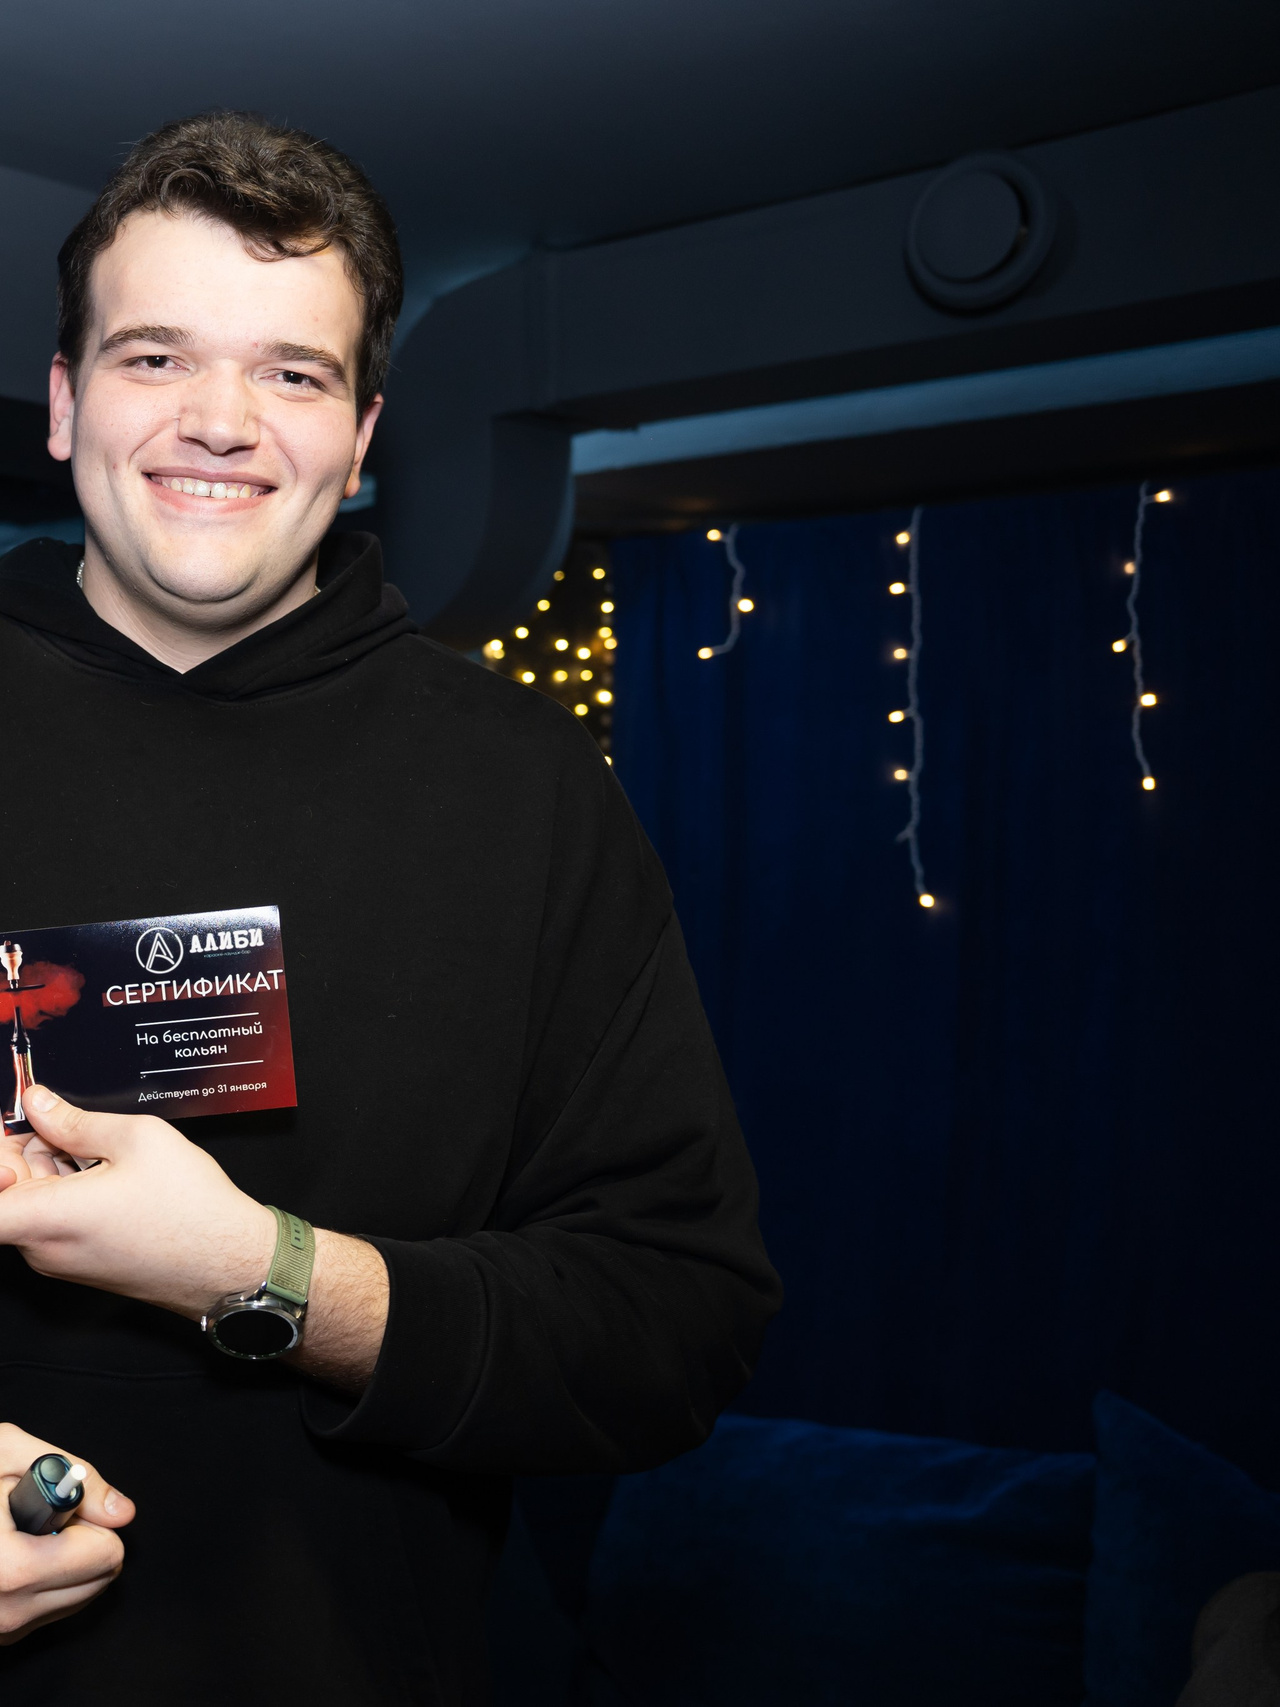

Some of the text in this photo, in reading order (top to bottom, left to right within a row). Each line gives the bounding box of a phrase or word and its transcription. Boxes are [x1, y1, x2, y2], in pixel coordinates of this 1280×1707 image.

[189, 928, 264, 953] АЛИБИ
[105, 969, 284, 1006] СЕРТИФИКАТ
[136, 1021, 263, 1046] На бесплатный
[174, 1044, 228, 1058] кальян
[137, 1081, 267, 1103] Действует до 31 января
